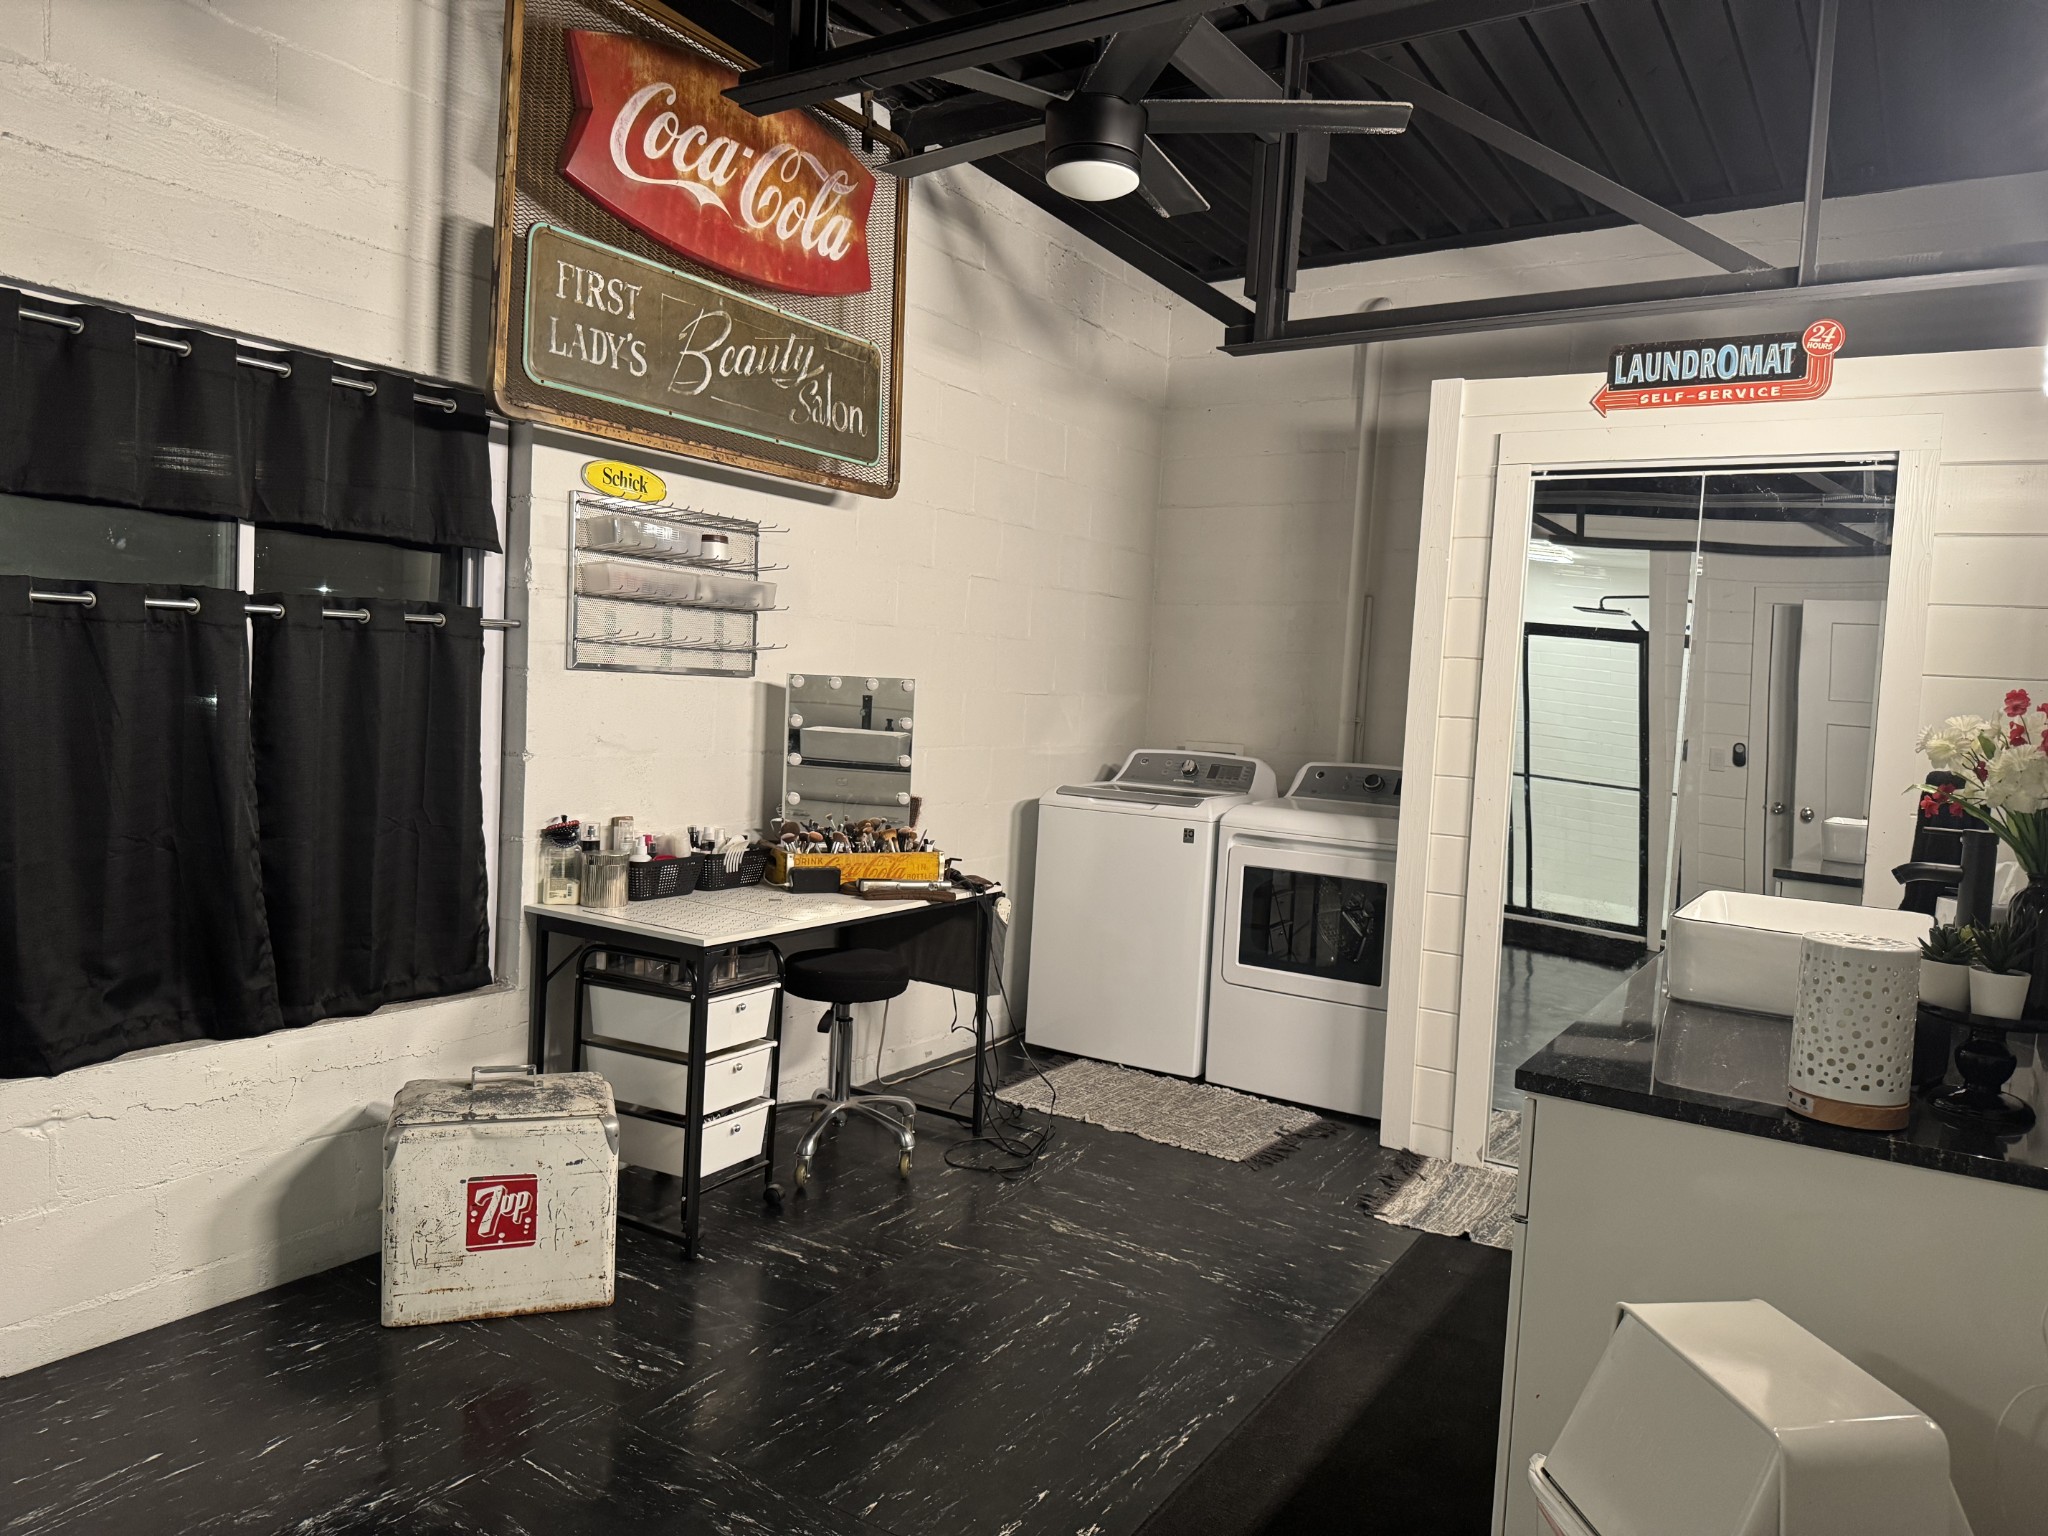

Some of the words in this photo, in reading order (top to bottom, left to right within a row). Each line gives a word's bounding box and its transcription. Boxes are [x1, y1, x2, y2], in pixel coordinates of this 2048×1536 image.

[609, 81, 859, 262] Coca-Cola
[556, 260, 642, 320] FIRST
[548, 317, 648, 378] LADY'S
[668, 307, 824, 397] Beauty
[1806, 342, 1833, 350] HOURS
[1809, 325, 1836, 342] 24
[1614, 342, 1797, 385] LAUNDROMAT
[789, 372, 867, 437] Salon
[1640, 386, 1781, 404] SELF-SERVICE
[602, 467, 648, 494] Schick
[795, 857, 823, 866] DRINK
